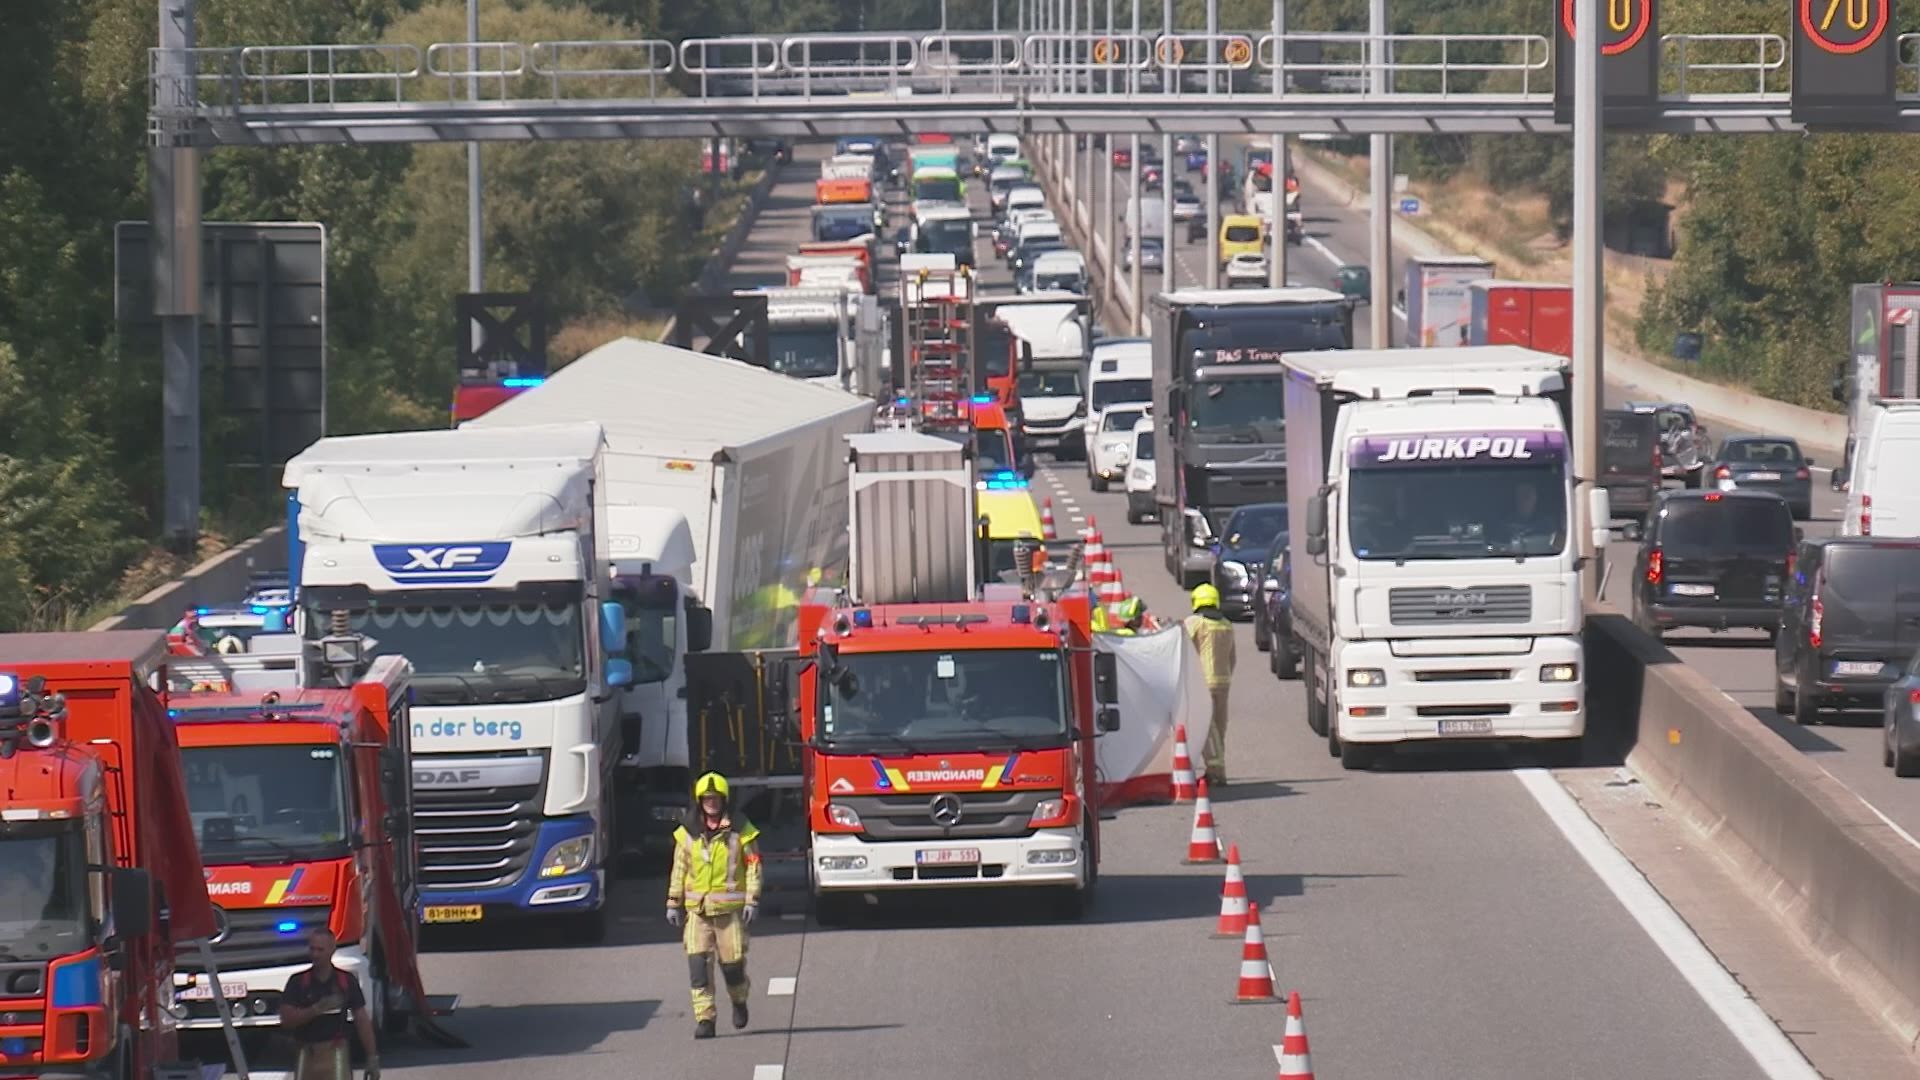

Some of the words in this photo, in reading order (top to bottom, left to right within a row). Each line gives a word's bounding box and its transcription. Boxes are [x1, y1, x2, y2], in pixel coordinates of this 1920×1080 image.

[1378, 437, 1532, 461] JURKPOL
[402, 547, 483, 570] XF
[1434, 593, 1487, 606] MAN
[430, 716, 467, 736] der
[473, 716, 522, 740] berg
[412, 770, 480, 784] DAF
